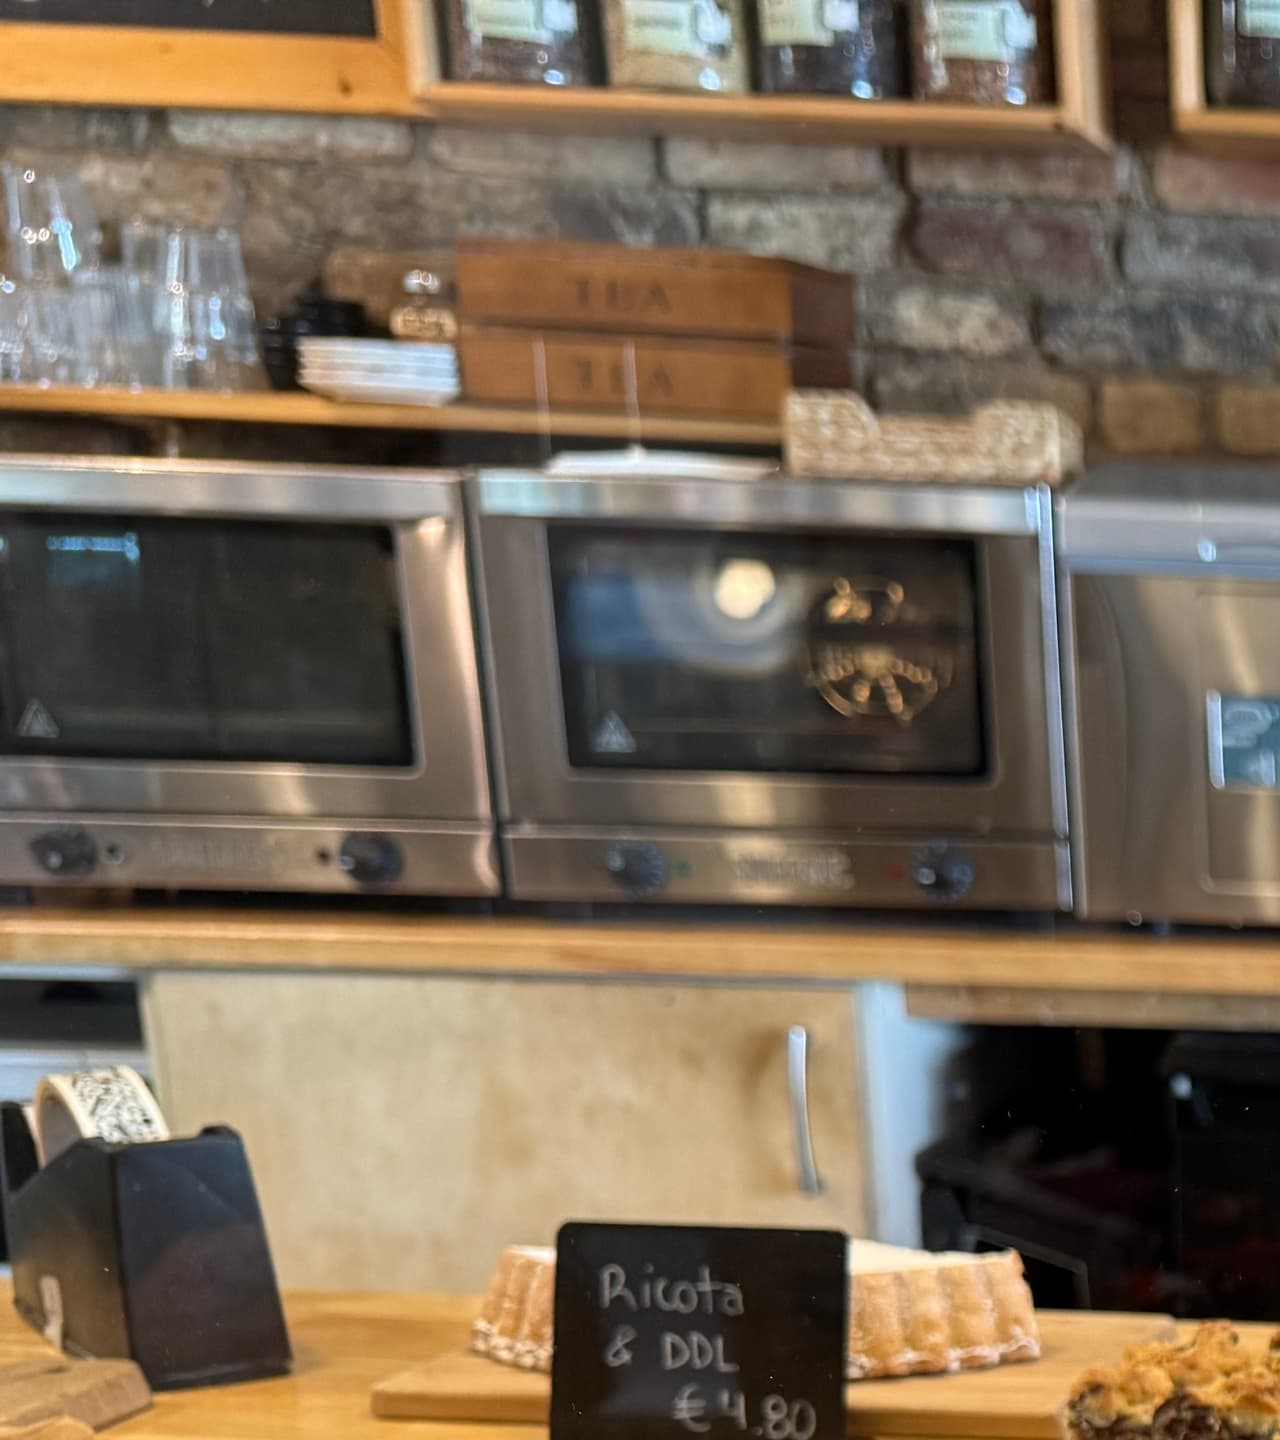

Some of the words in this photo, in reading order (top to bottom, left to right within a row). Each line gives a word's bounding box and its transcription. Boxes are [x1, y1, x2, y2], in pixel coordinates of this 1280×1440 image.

[601, 1263, 744, 1316] Ricota
[604, 1324, 637, 1367] &
[662, 1331, 740, 1372] DDL
